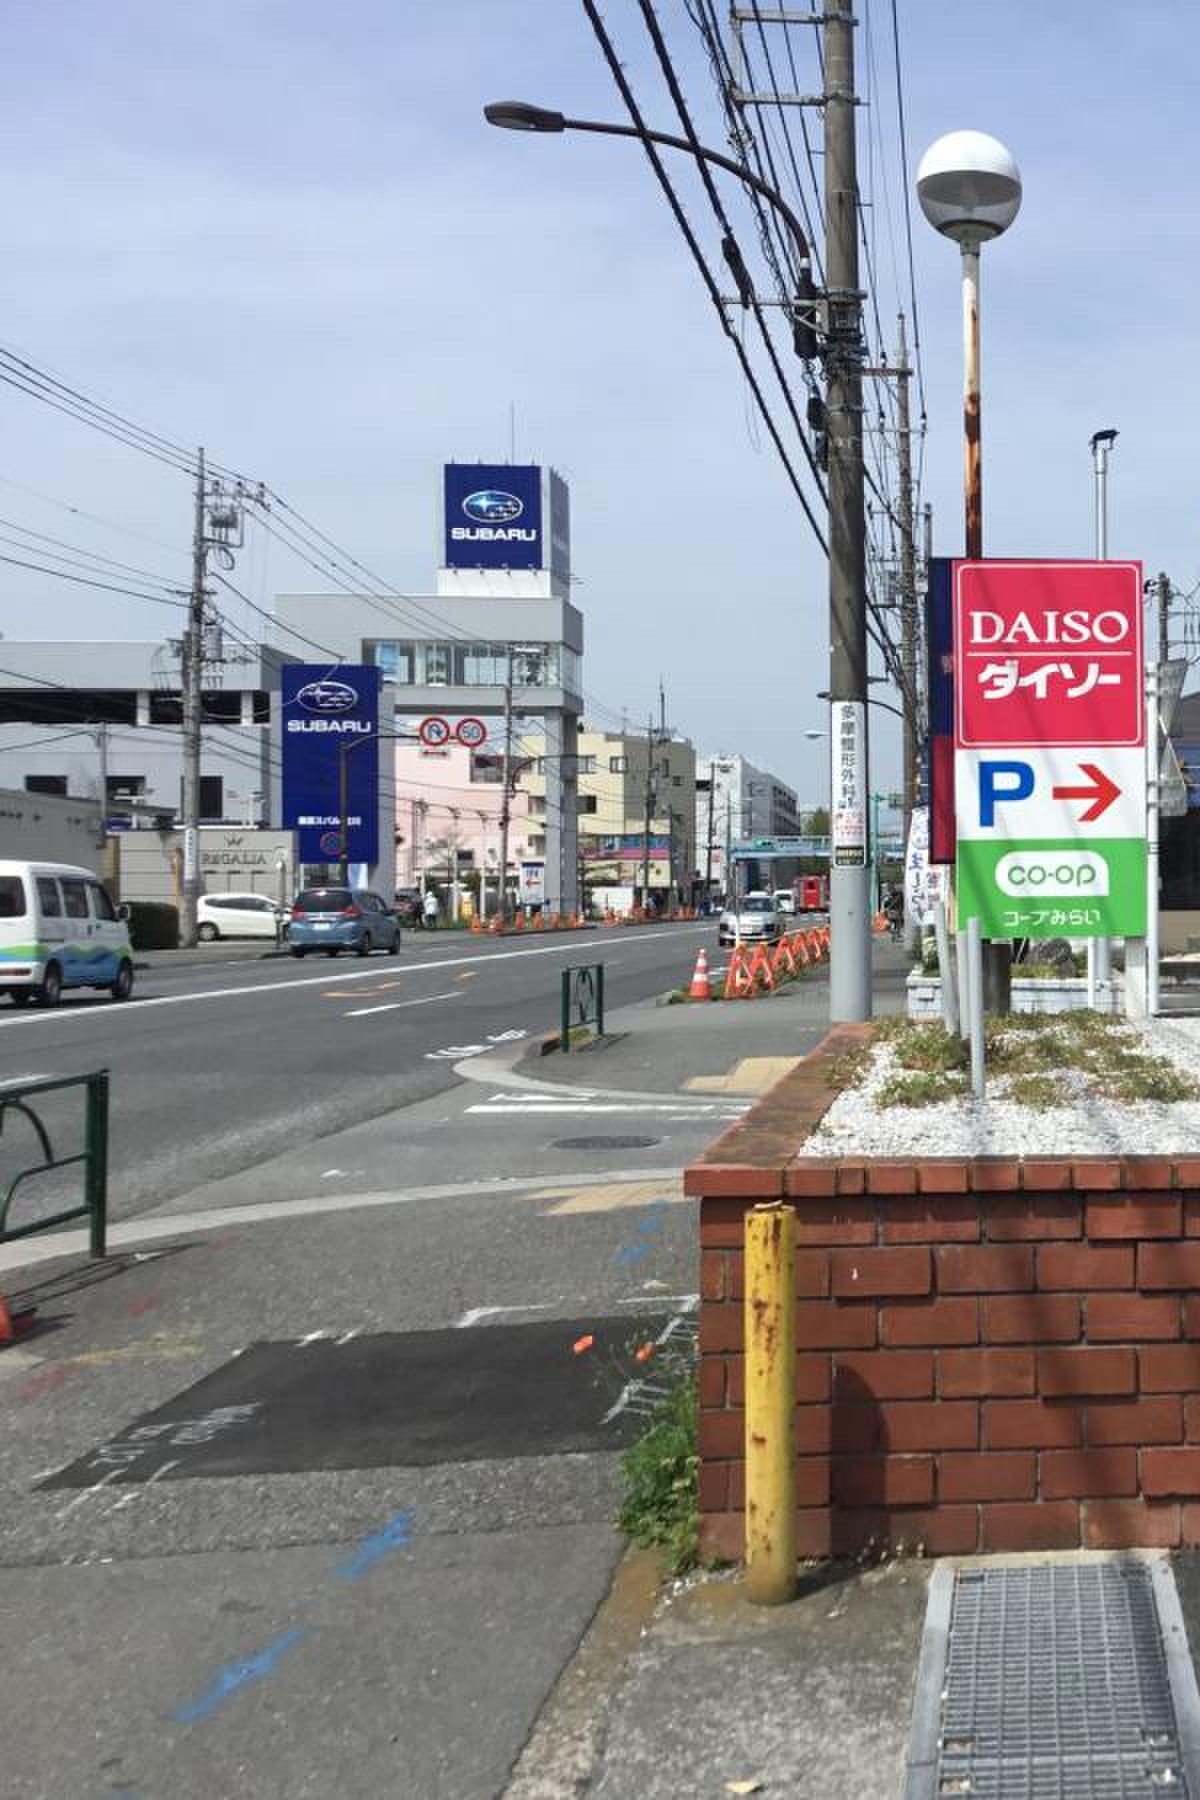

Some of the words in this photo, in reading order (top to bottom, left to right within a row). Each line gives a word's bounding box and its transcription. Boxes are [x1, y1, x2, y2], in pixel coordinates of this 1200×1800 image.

[451, 527, 537, 542] SUBARU
[968, 611, 1129, 644] DAISO
[978, 660, 1121, 699] ダイソー
[287, 719, 371, 733] SUBARU
[978, 761, 1035, 827] P
[202, 853, 267, 865] REGALIA
[1004, 910, 1101, 926] コープみらい
